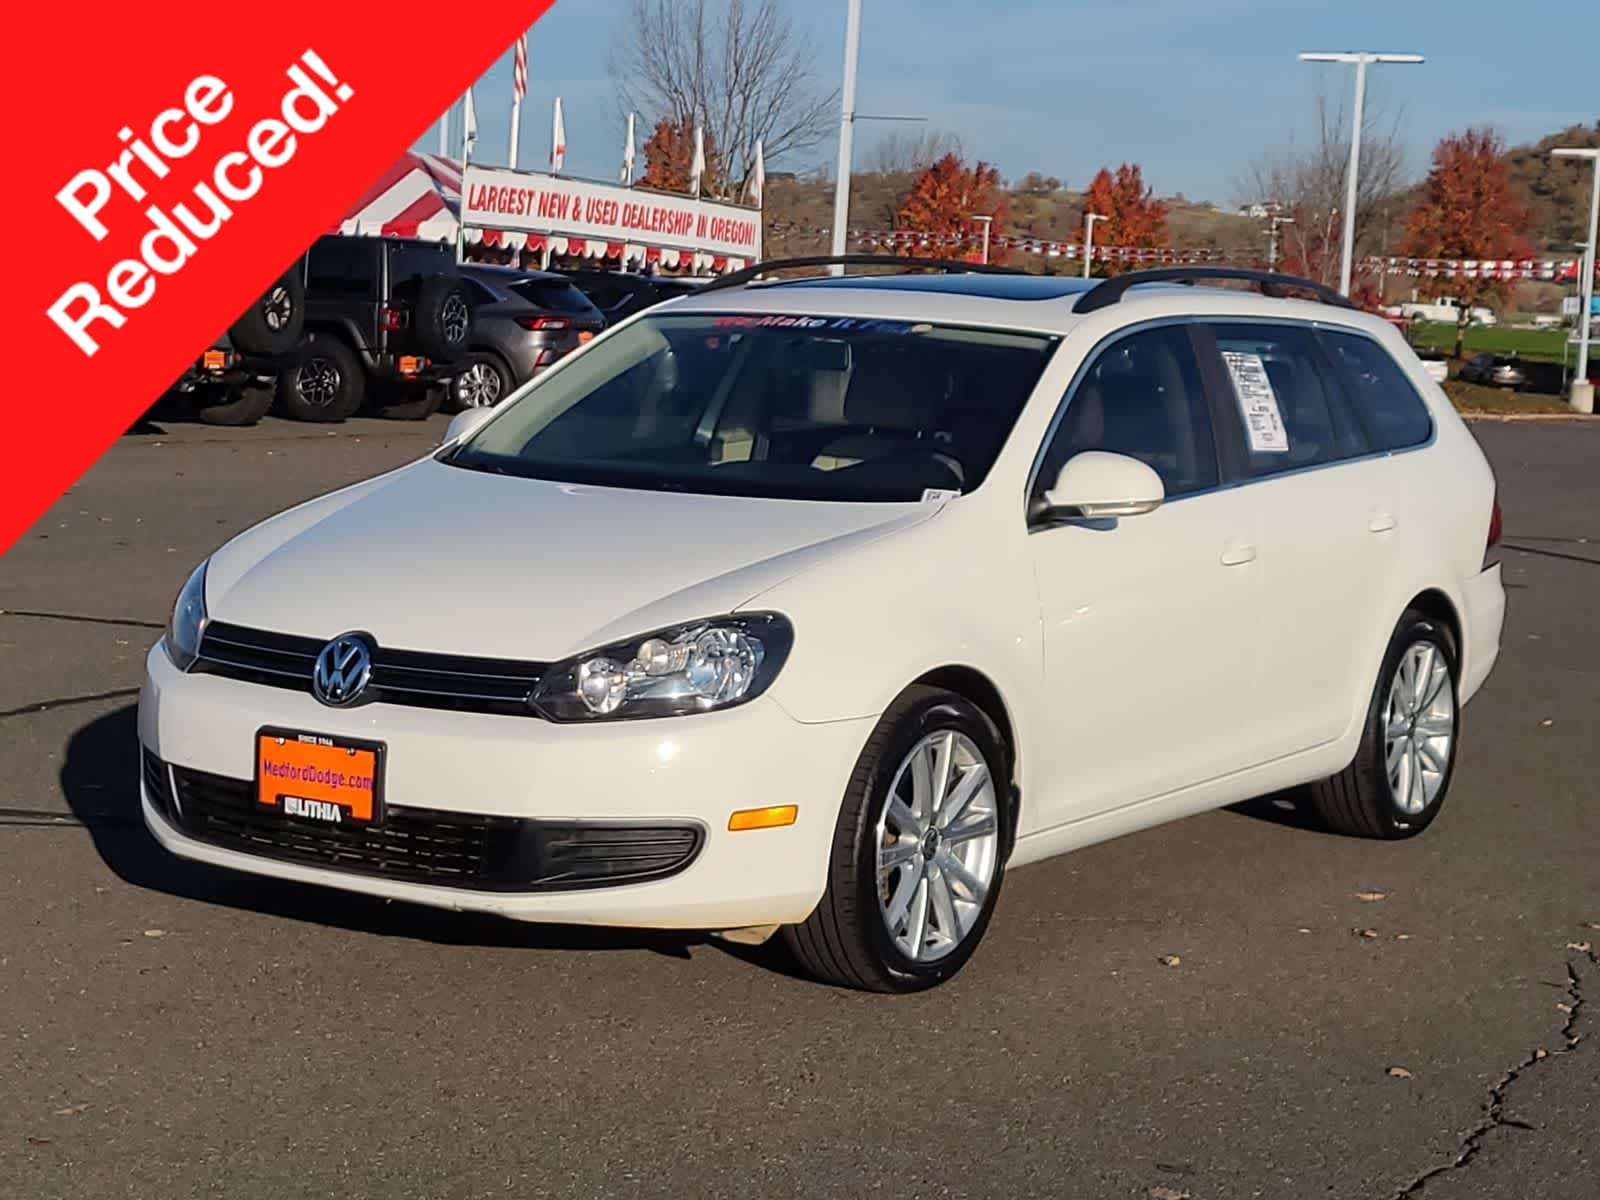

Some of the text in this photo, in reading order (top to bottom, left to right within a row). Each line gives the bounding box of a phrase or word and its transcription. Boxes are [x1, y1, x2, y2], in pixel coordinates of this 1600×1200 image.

[467, 183, 756, 246] LARGEST NEW & USED DEALERSHIP IN OREGON!
[756, 316, 827, 327] Make
[314, 634, 371, 705] VW
[263, 759, 373, 790] MedfordDodge.com
[298, 799, 341, 823] LITHIA
